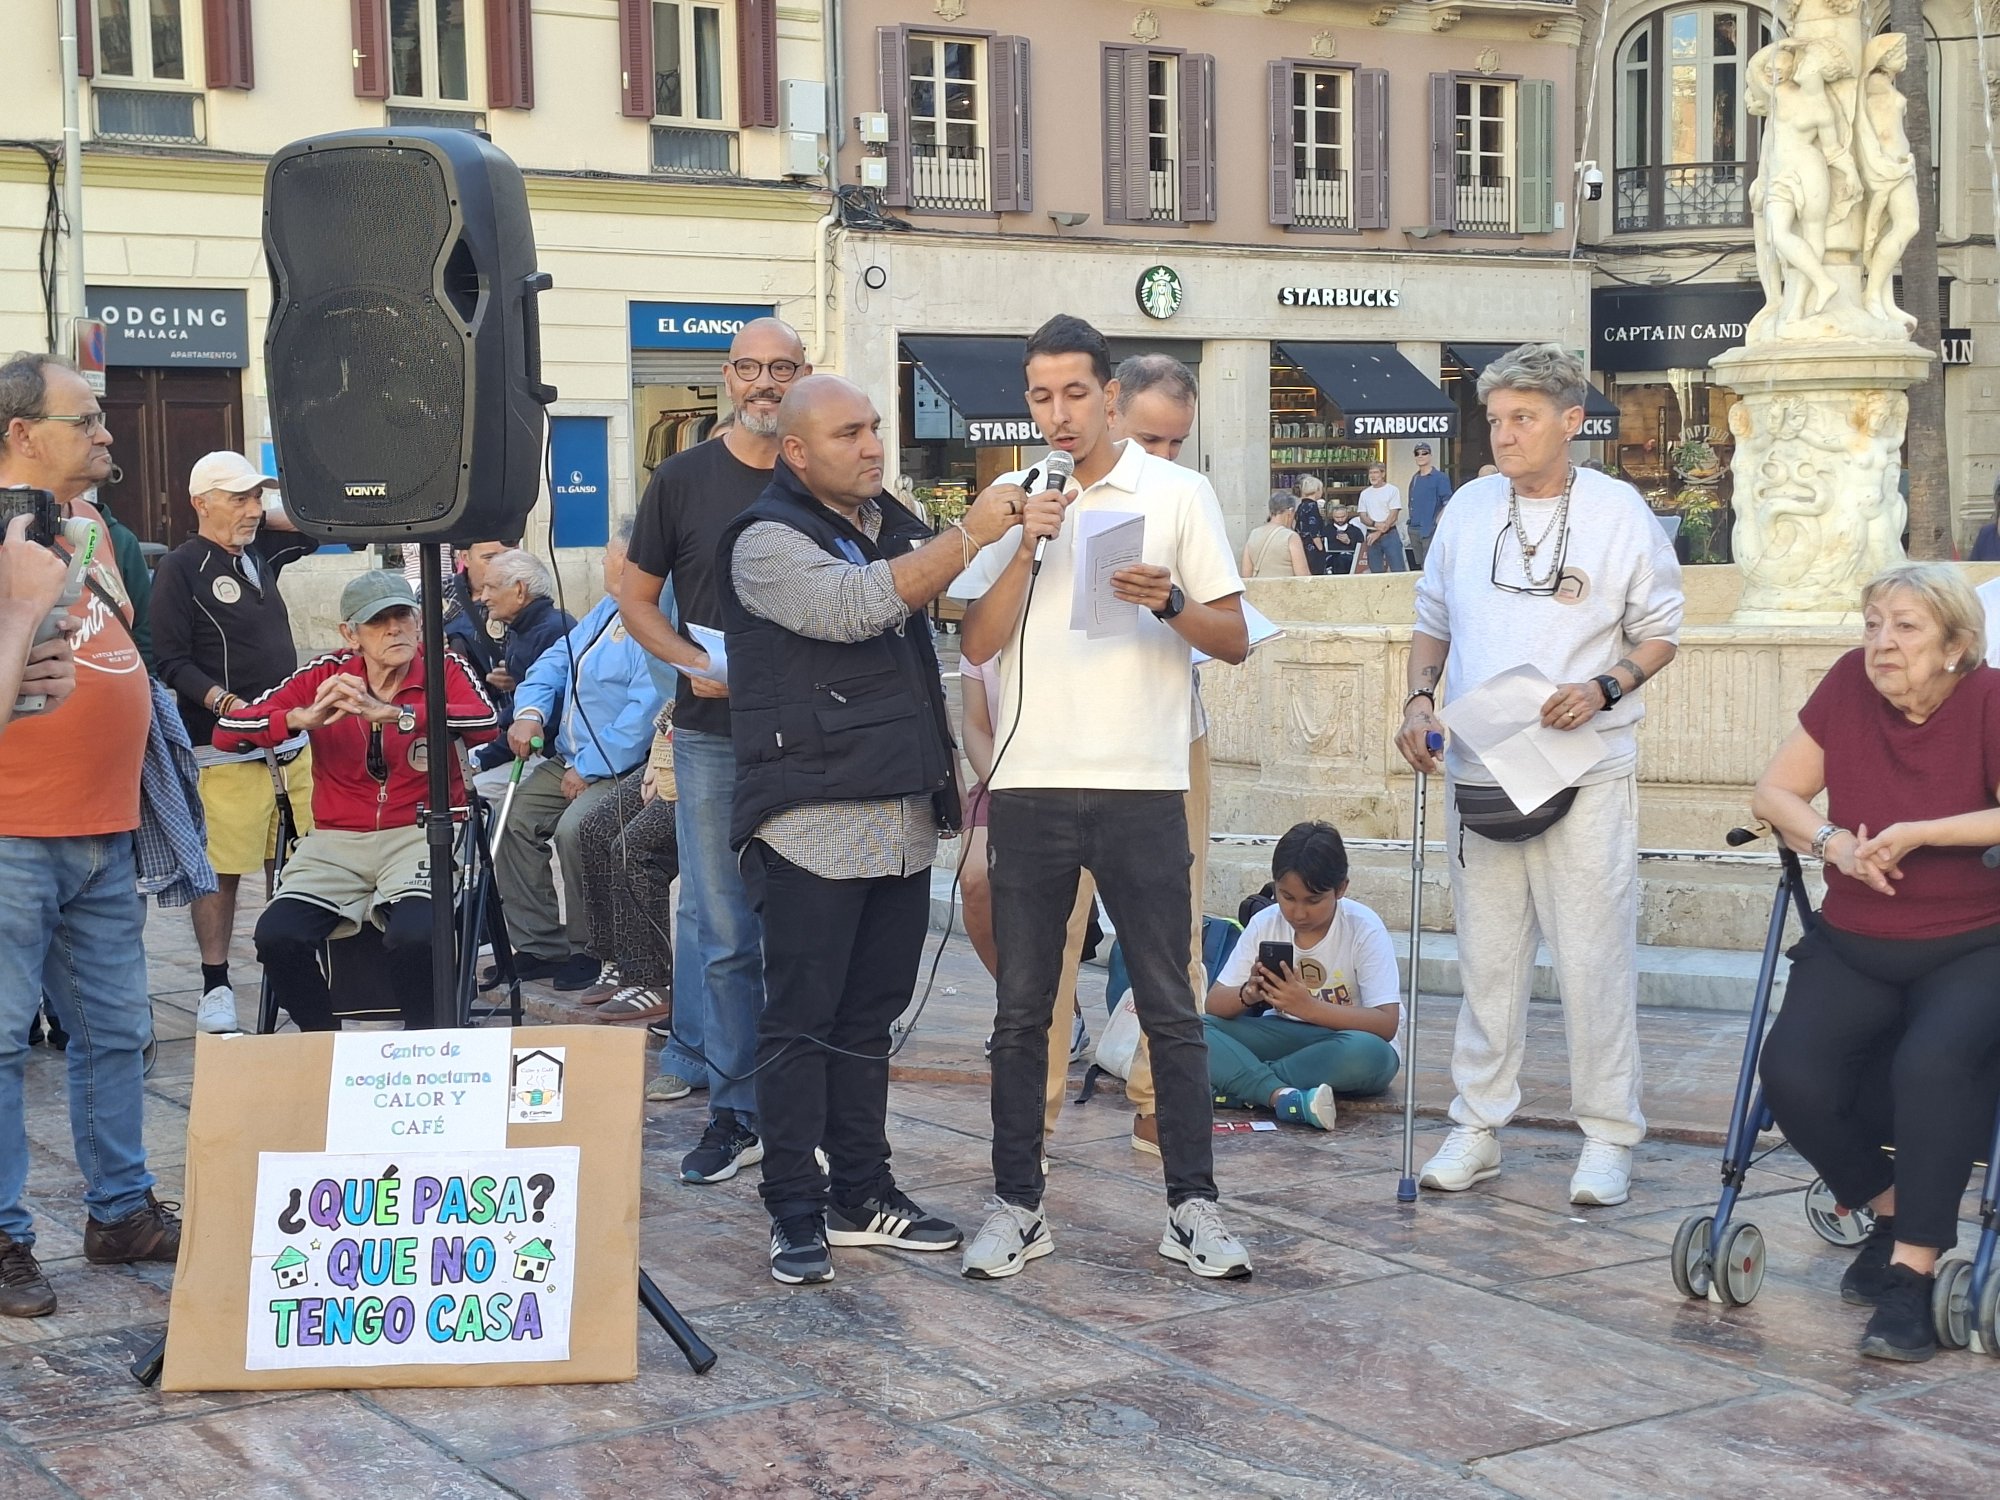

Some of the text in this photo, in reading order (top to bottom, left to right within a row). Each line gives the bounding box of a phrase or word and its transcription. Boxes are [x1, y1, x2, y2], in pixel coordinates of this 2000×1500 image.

[1282, 287, 1400, 307] STARBUCKS
[85, 305, 228, 327] ODGING
[658, 317, 745, 334] EL GANSO
[124, 328, 189, 340] MALAGA
[1604, 325, 1687, 342] CAPTAIN
[170, 351, 238, 360] APARTAMENTOS
[969, 421, 1043, 441] STARBU
[1354, 416, 1449, 434] STARBUCKS
[345, 486, 386, 496] VONYX
[557, 485, 597, 494] EL GANSO
[380, 1041, 461, 1060] Centro de
[345, 1069, 492, 1090] acogida nocturna
[373, 1090, 466, 1108] CALOR Y
[391, 1115, 445, 1136] CAFÉ
[278, 1164, 555, 1235] ¿QUÉ PASA?
[327, 1236, 496, 1291] QUE NO
[270, 1292, 543, 1347] TENGO CASA
